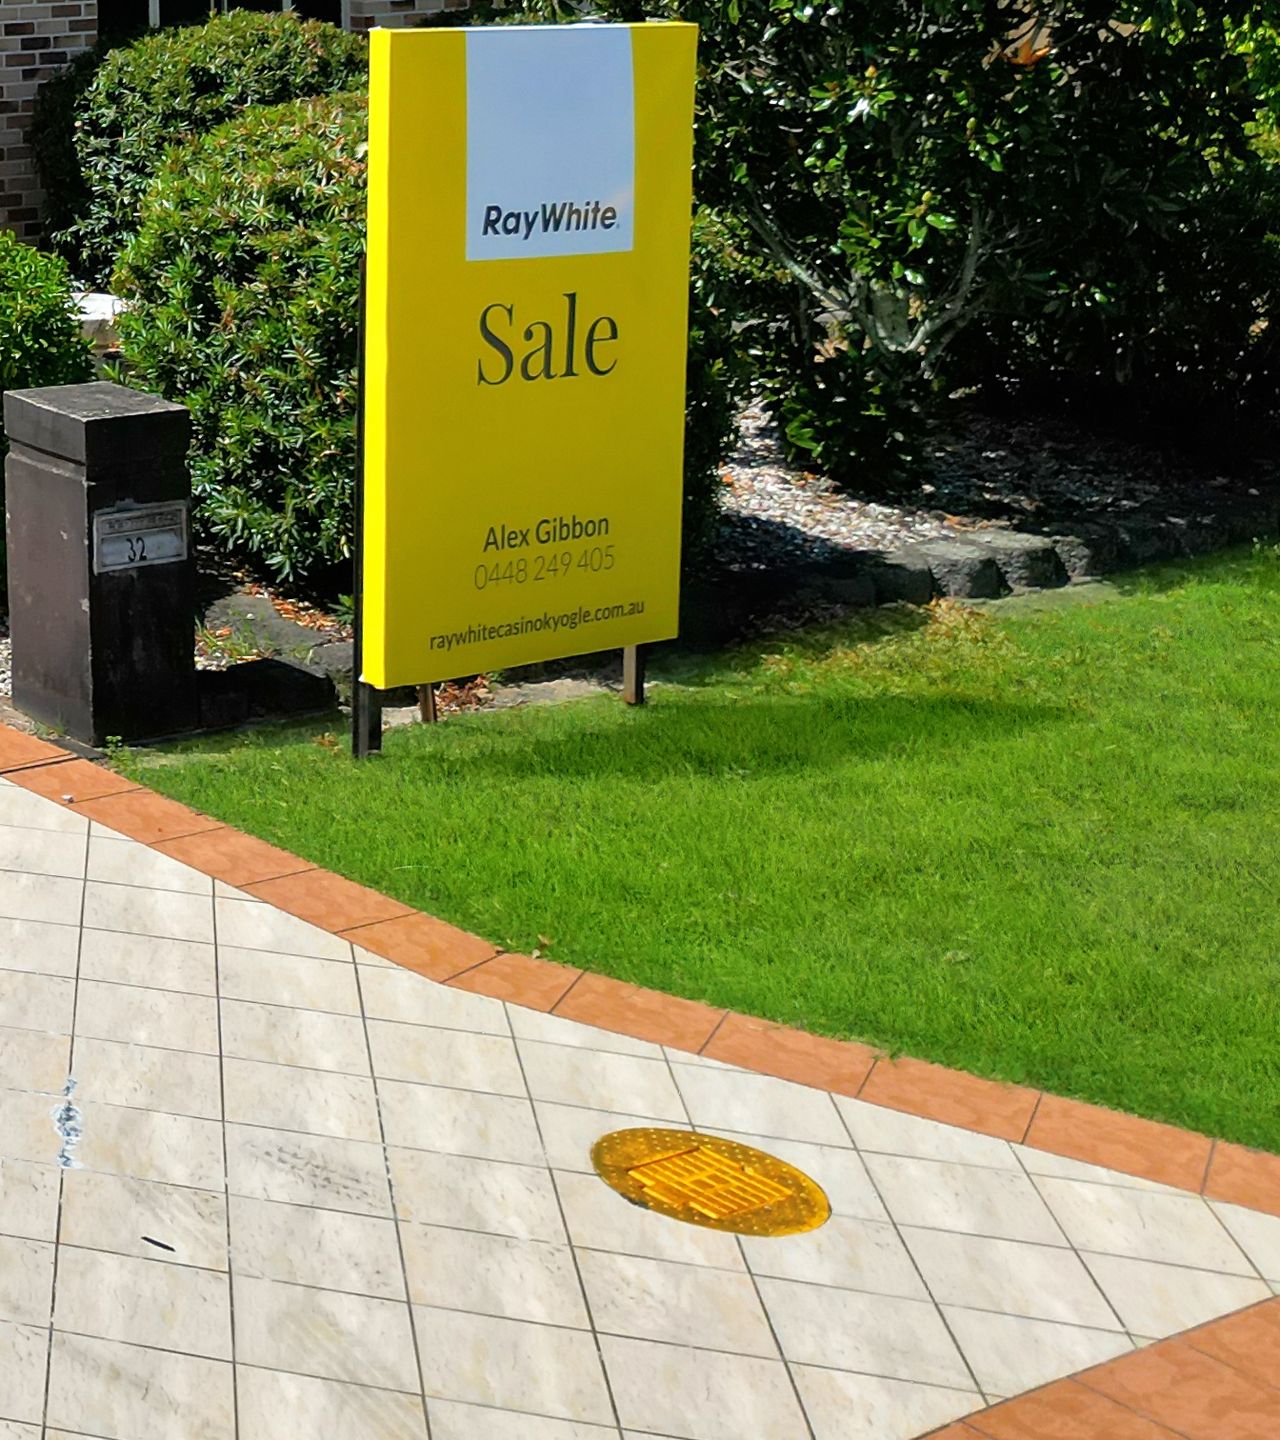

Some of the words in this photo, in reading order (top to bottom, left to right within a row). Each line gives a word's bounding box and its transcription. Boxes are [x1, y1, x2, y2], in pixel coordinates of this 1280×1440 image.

[477, 292, 618, 386] Sale
[126, 536, 148, 562] 32
[483, 524, 531, 553] Alex
[535, 514, 609, 545] Gibbon
[474, 558, 528, 590] 0448
[533, 551, 572, 581] 249
[577, 544, 616, 573] 405
[429, 601, 645, 651] raywhitecasinokyogle.com.au
